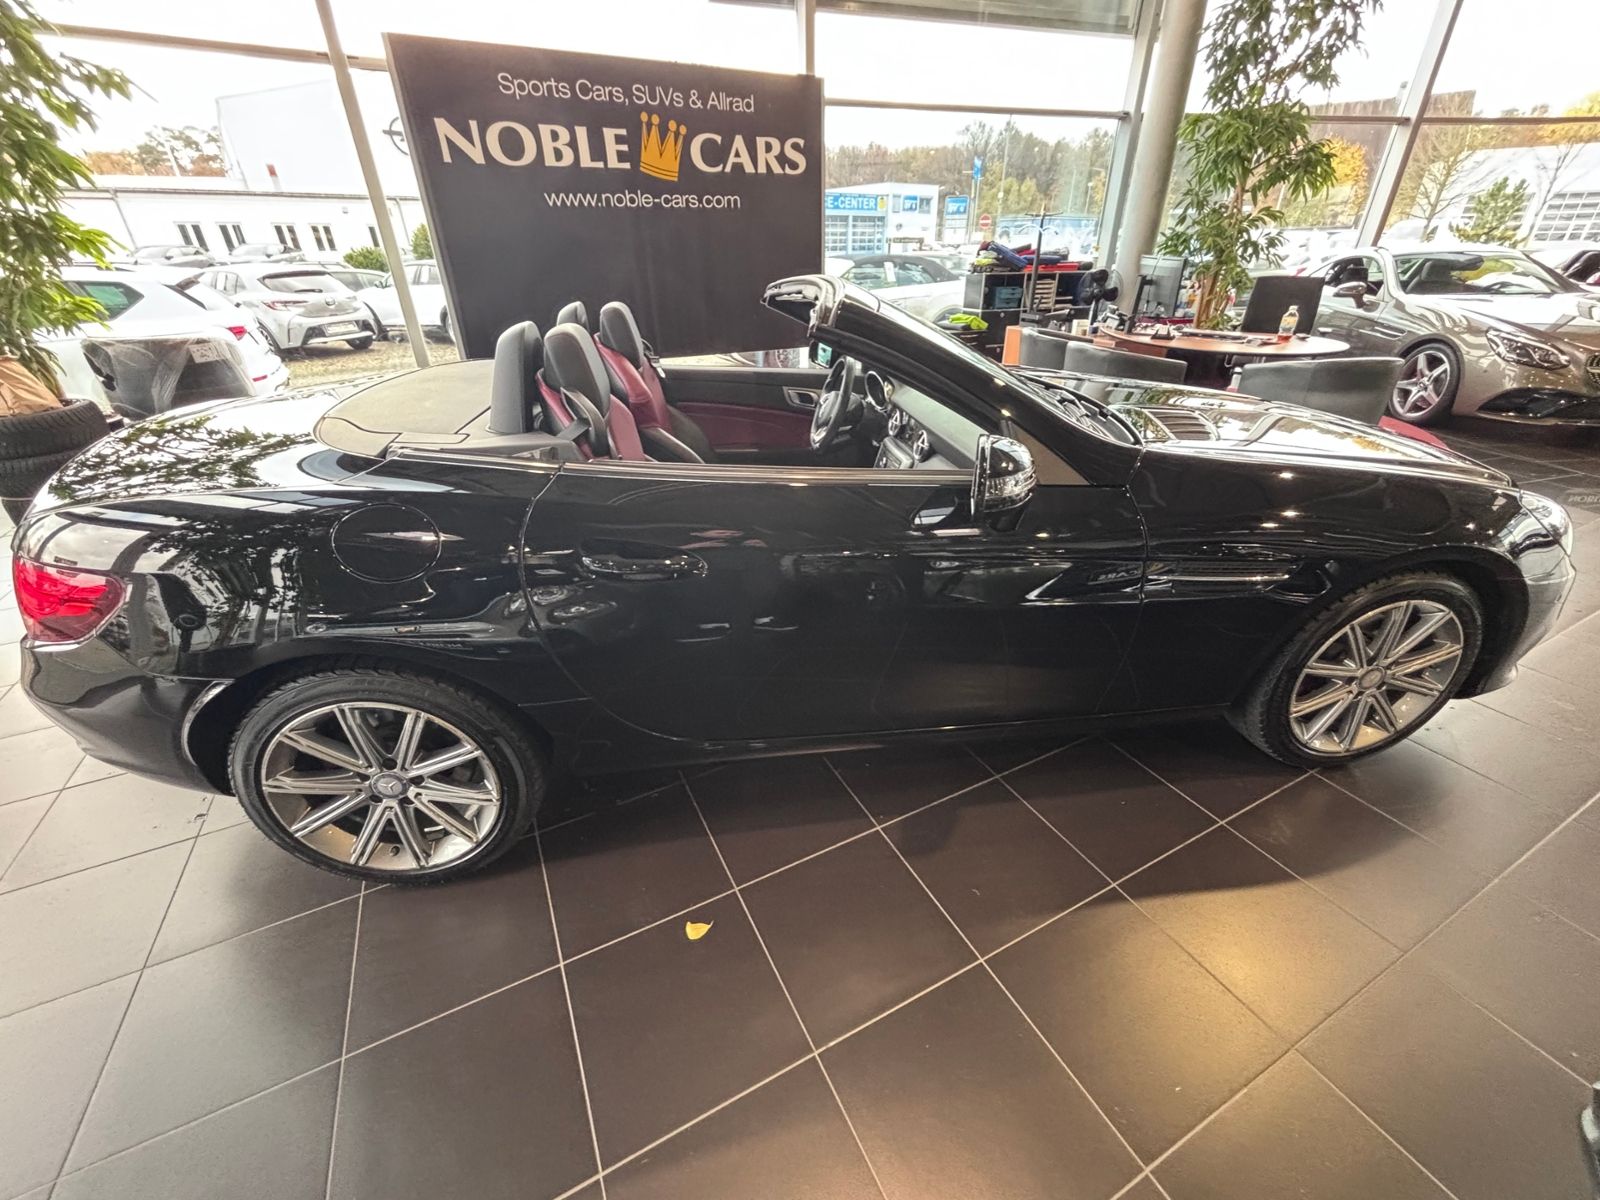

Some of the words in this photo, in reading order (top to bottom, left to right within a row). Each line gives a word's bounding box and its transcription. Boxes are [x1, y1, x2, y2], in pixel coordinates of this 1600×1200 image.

[497, 72, 571, 100] Sports
[575, 79, 629, 106] Cars,
[632, 84, 684, 107] SUVs
[689, 89, 704, 109] &
[706, 91, 755, 112] Allrad
[433, 117, 631, 170] NOBLE
[690, 132, 807, 175] CARS
[544, 190, 741, 209] www.noble-cars.com
[825, 196, 876, 209] E-CENTER
